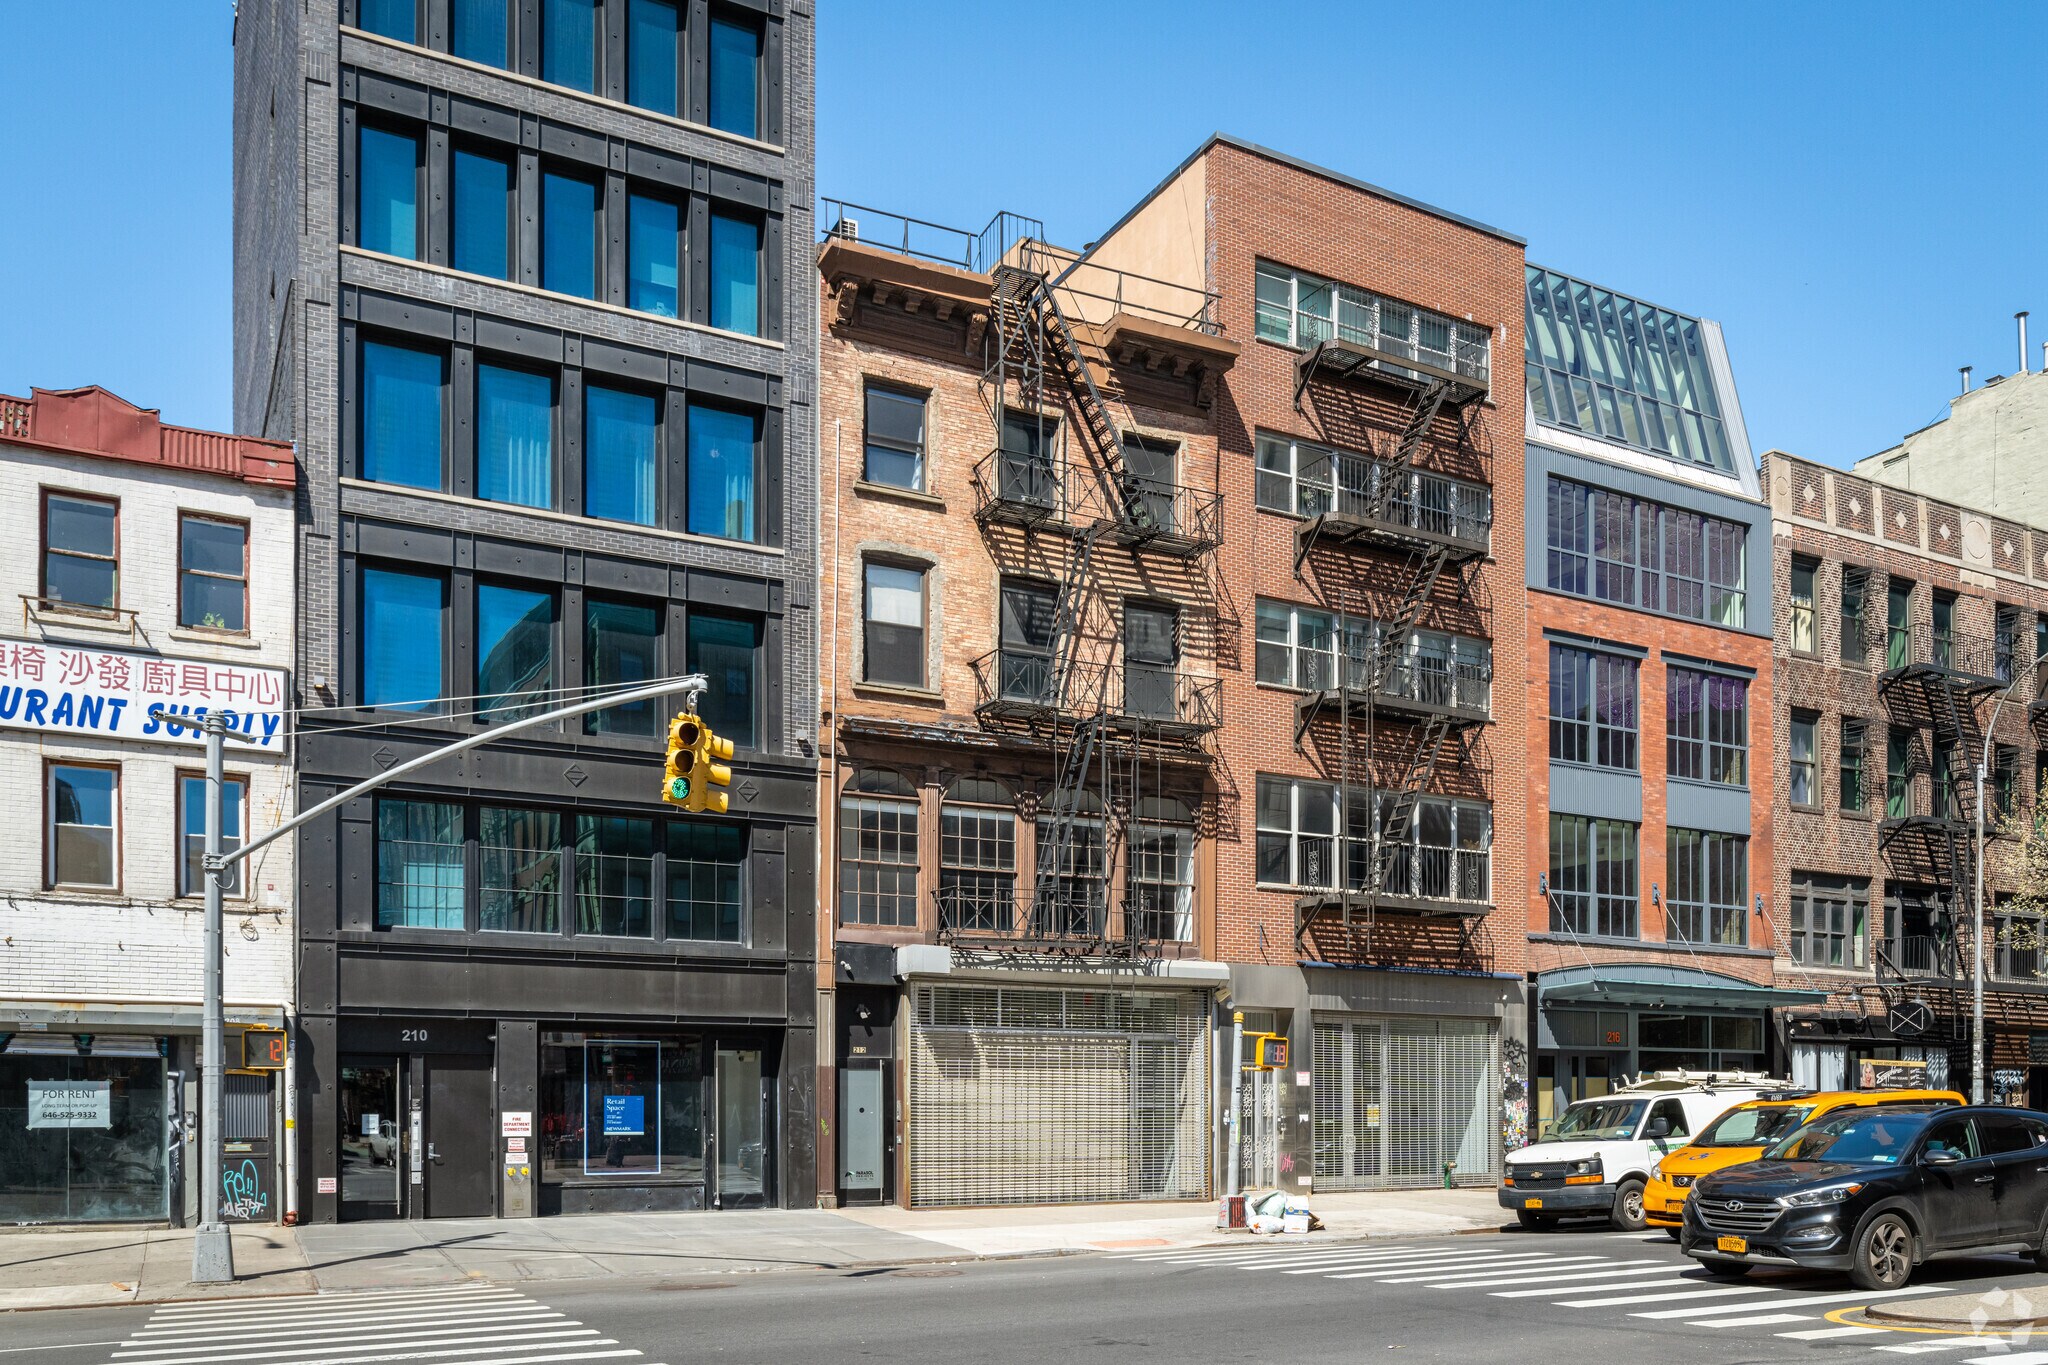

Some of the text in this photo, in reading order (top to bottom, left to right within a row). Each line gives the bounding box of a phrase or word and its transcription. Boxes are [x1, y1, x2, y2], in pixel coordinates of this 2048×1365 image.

[0, 644, 280, 705] 椅 沙發 廚具中心
[402, 1029, 428, 1042] 210
[1607, 1031, 1621, 1043] 216
[269, 1039, 283, 1062] 12
[42, 1090, 97, 1099] FOR RENT
[42, 1111, 97, 1119] 646-525-9332
